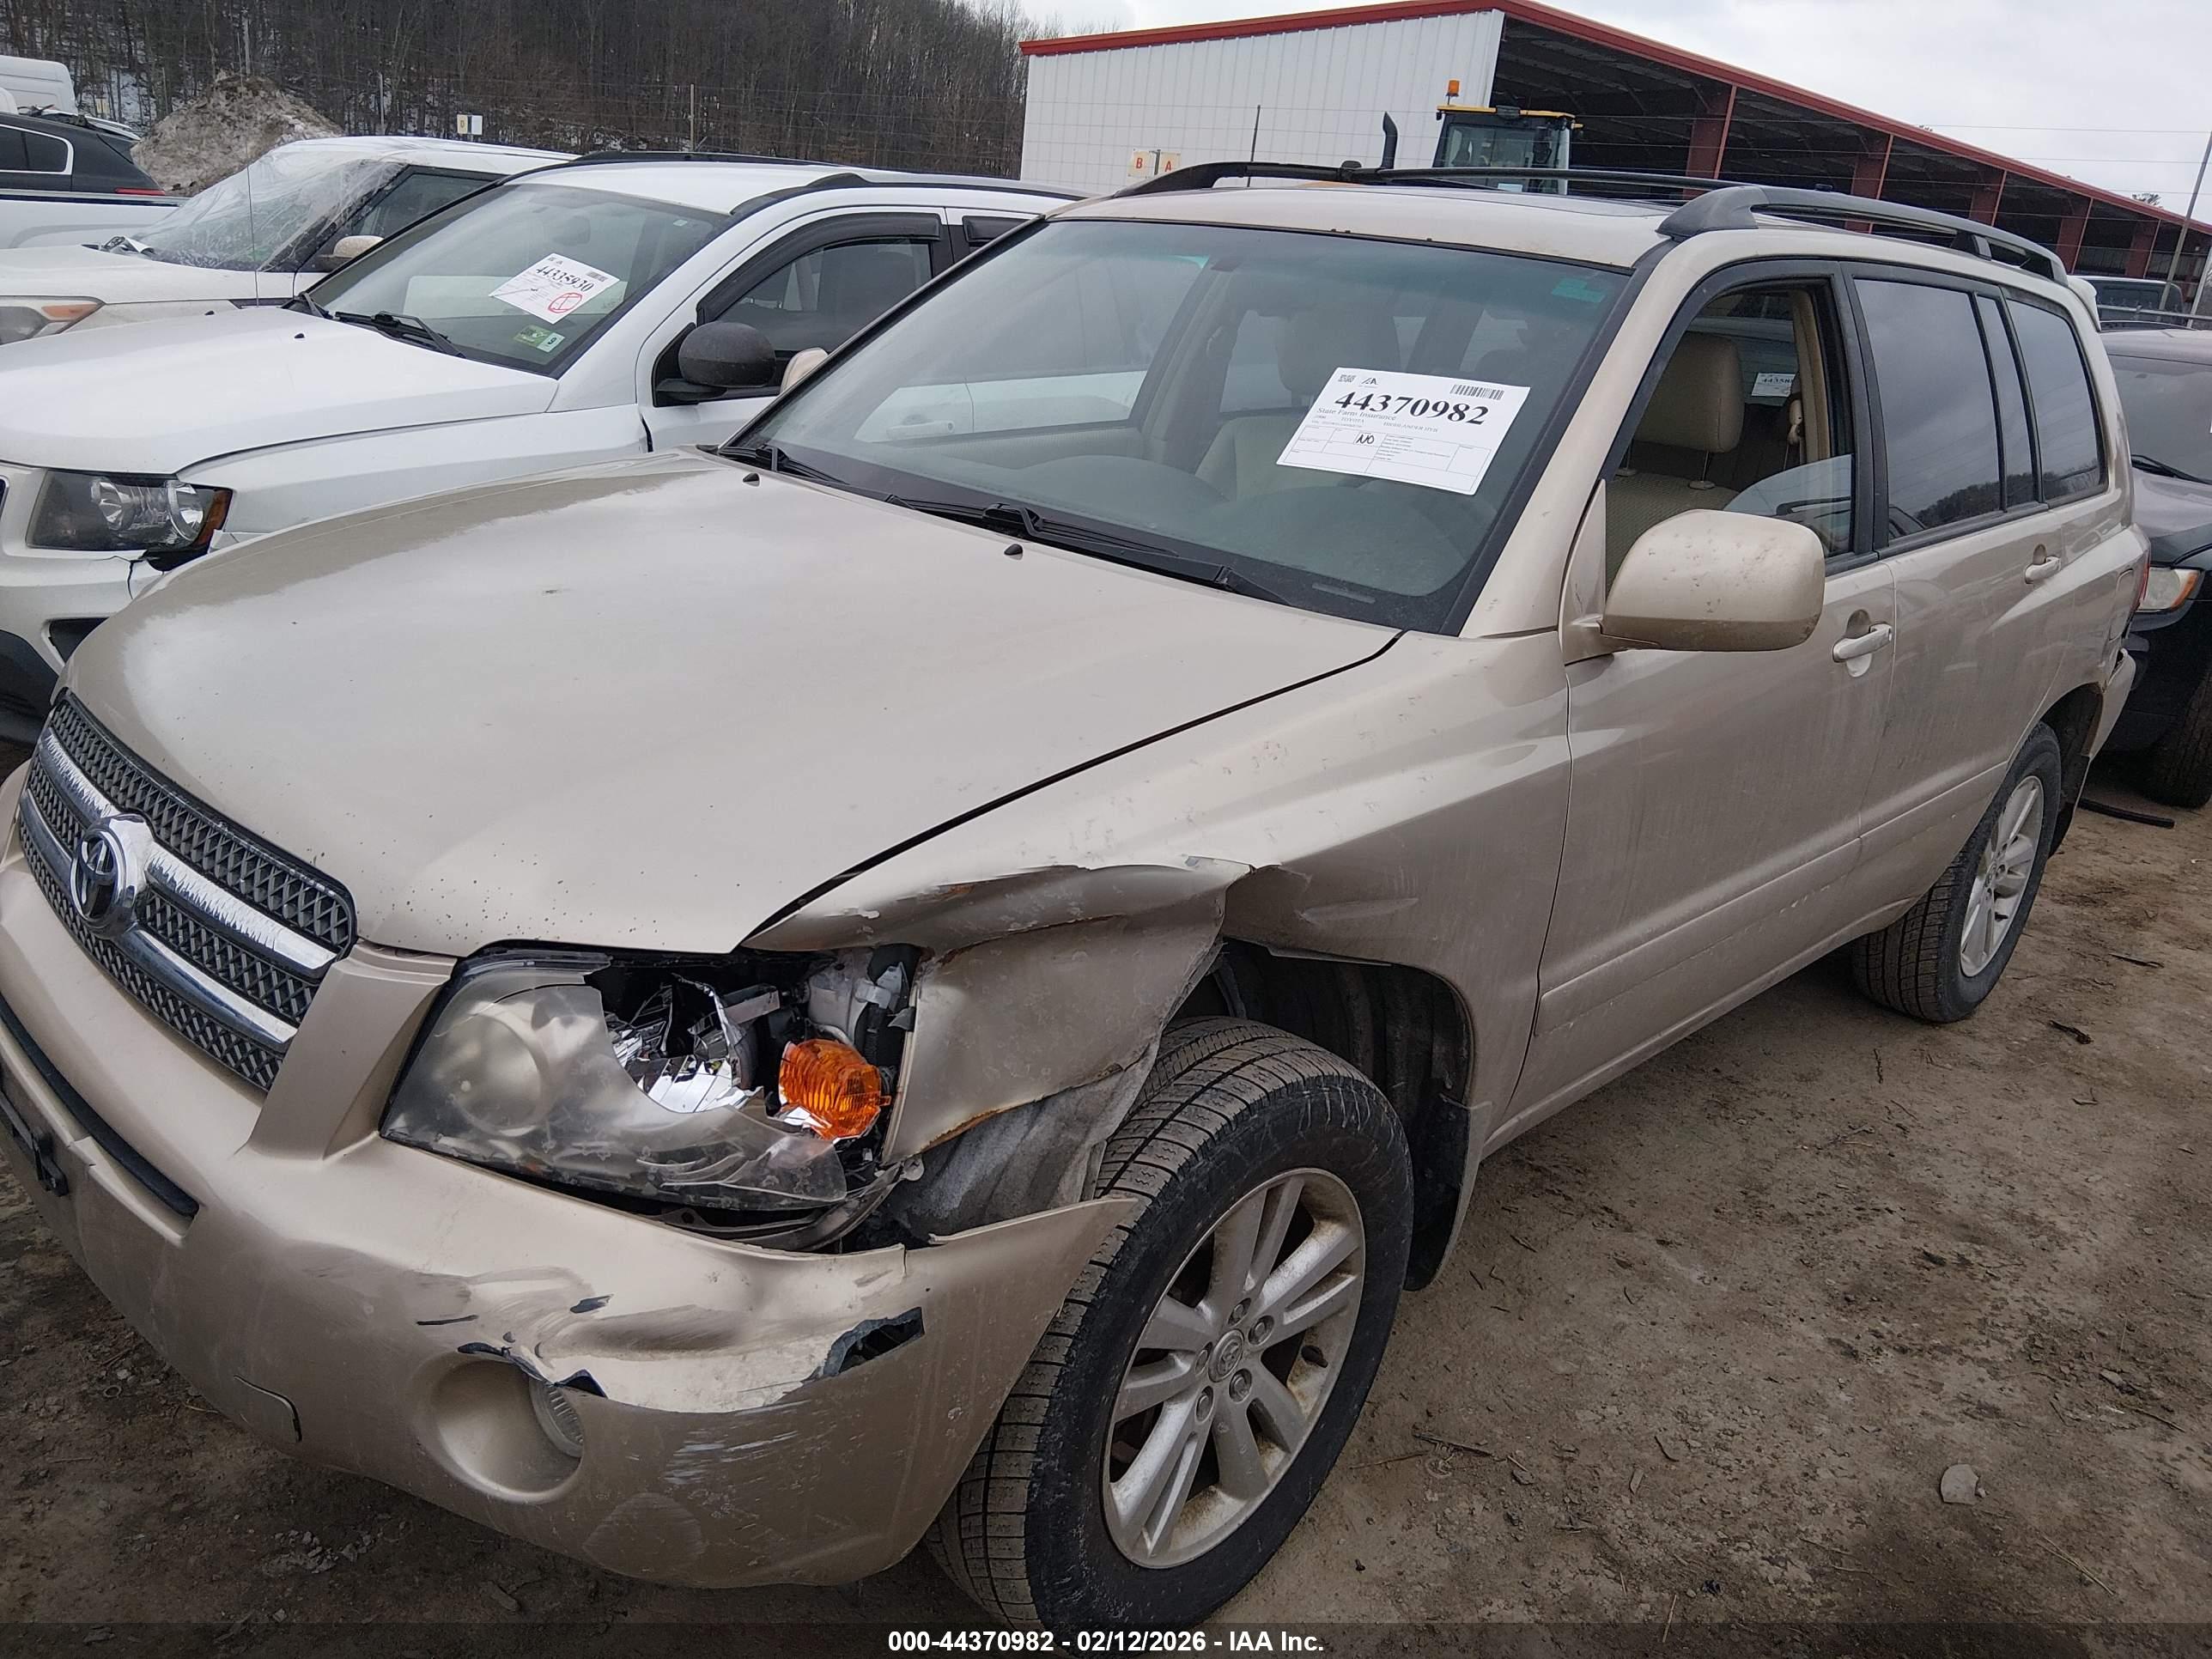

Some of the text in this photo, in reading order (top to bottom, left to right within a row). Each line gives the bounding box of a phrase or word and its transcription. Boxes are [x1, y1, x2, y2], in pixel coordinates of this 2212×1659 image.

[1135, 157, 1143, 169] B
[1164, 161, 1172, 173] A
[536, 265, 594, 292] 44335930
[1334, 391, 1489, 425] 44370982
[1338, 409, 1358, 417] Farm
[1359, 411, 1396, 421] Insurance
